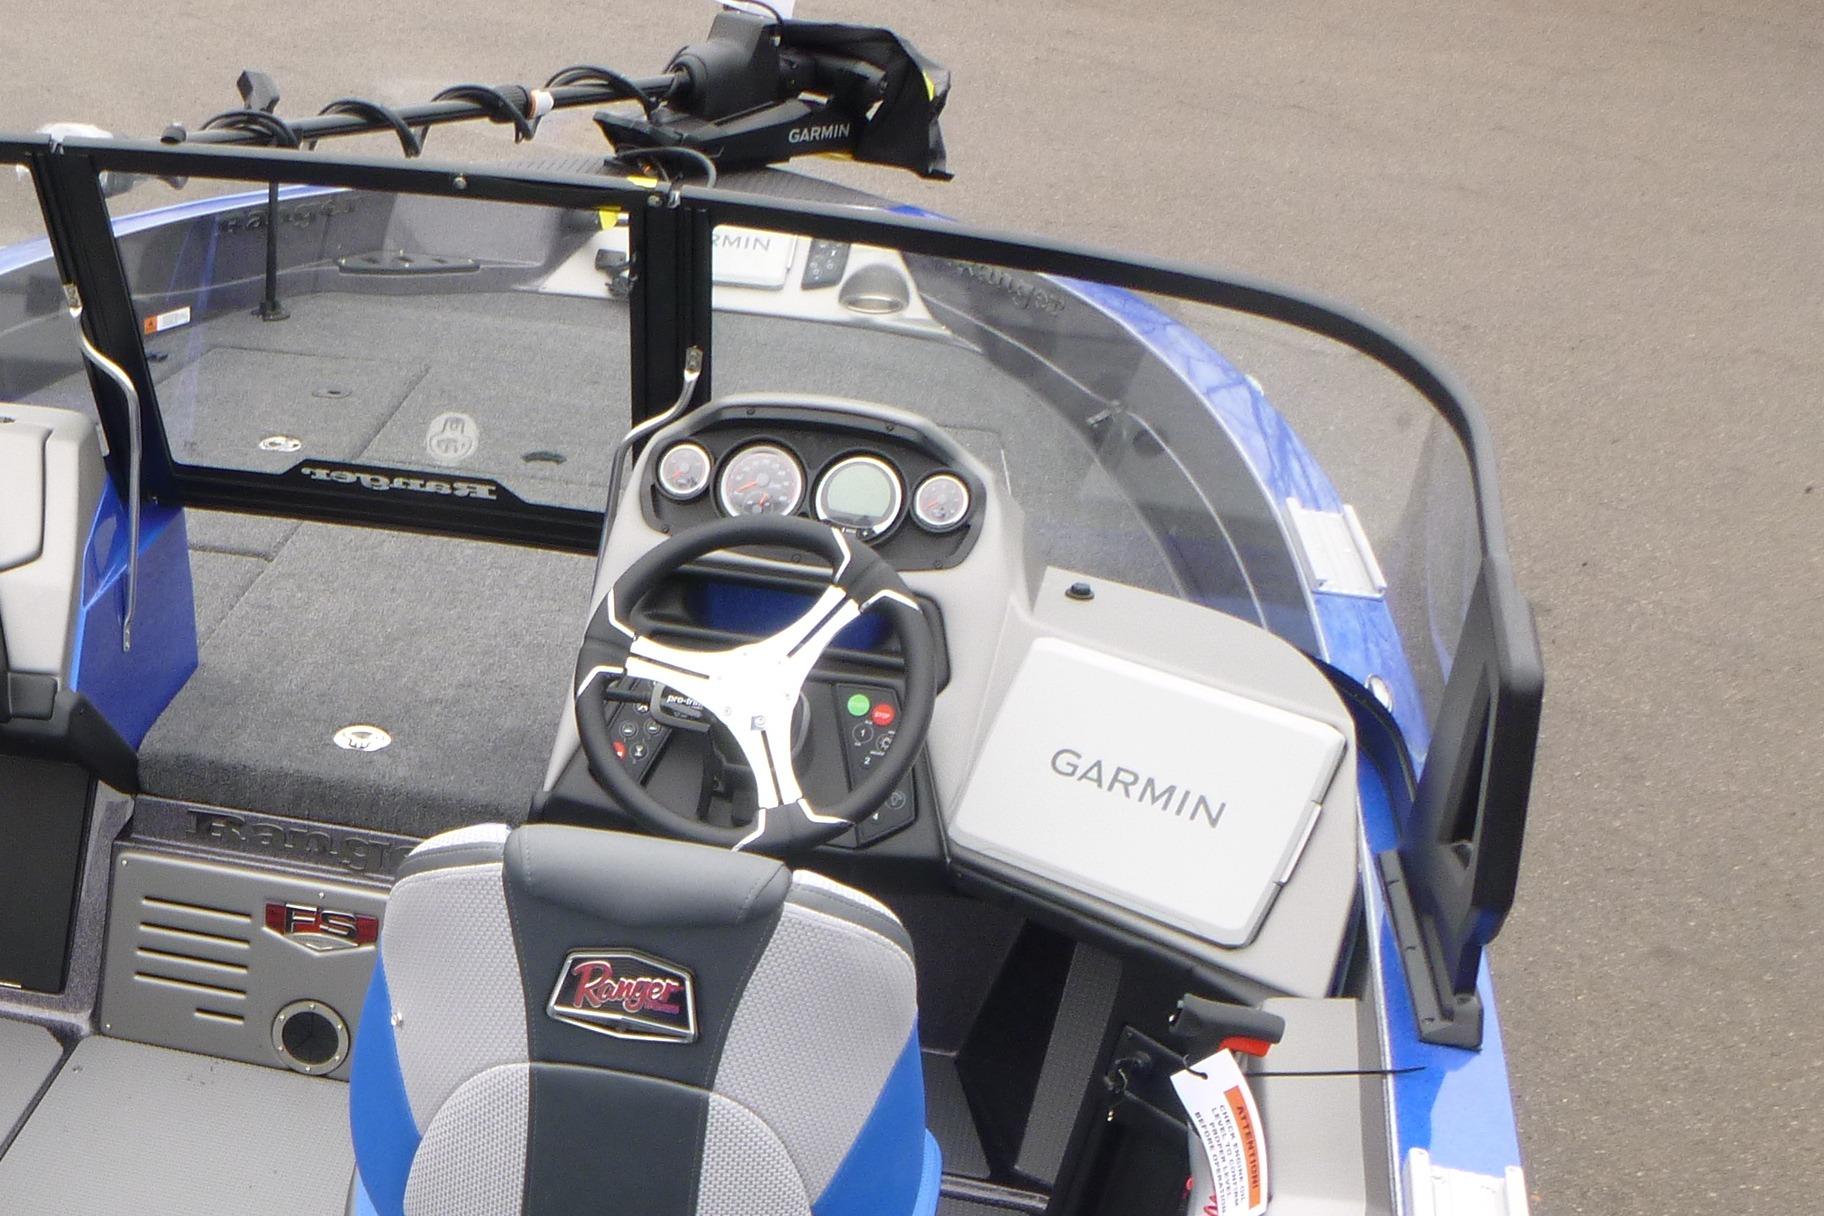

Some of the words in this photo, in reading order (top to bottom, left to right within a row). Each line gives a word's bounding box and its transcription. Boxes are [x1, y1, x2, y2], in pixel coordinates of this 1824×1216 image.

[788, 122, 851, 144] GARMIN
[1050, 748, 1226, 829] GARMIN
[283, 902, 358, 938] FS
[571, 959, 685, 1014] Ranger
[1194, 1111, 1215, 1150] BEFORE
[1211, 1107, 1227, 1141] LEVEL
[1219, 1104, 1236, 1141] CHECK
[1232, 1142, 1244, 1182] ENGINE
[1237, 1105, 1260, 1190] ATTENTION!
[1209, 1121, 1226, 1163] PROPER
[1222, 1165, 1232, 1197] LEVEL
